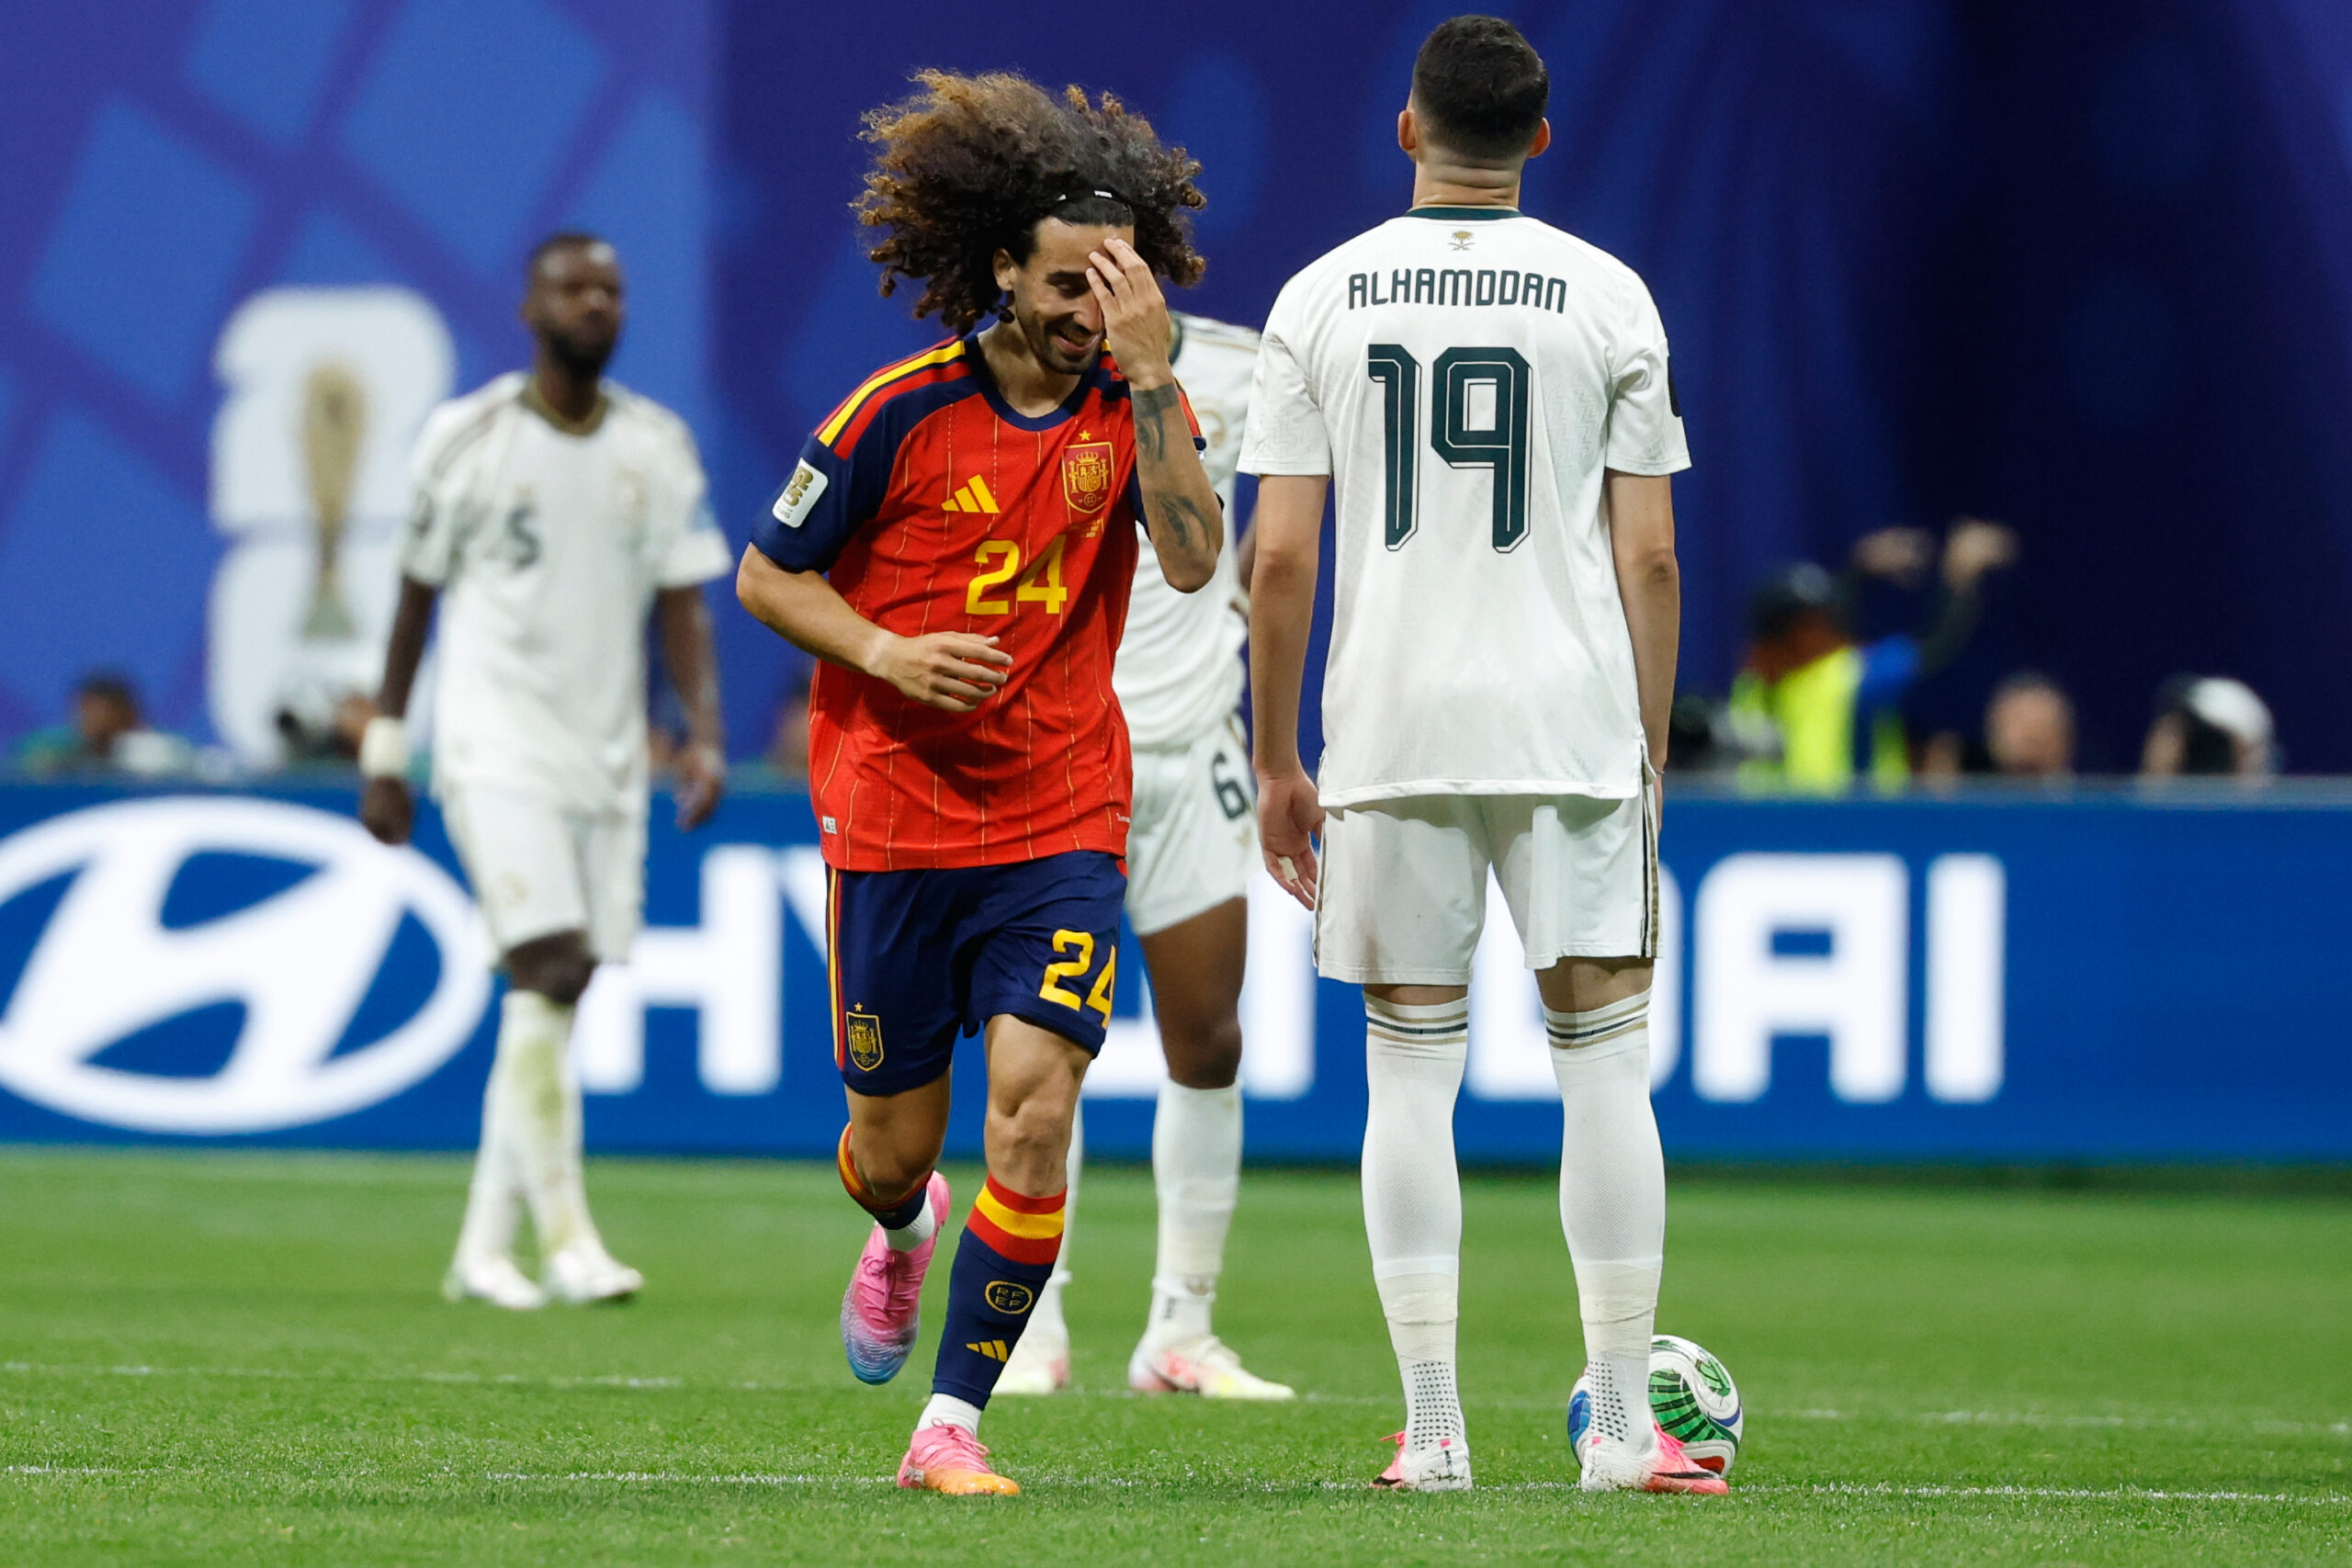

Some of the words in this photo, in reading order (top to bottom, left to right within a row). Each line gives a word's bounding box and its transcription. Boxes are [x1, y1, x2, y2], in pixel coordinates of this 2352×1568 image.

[1368, 344, 1533, 554] 19
[965, 535, 1068, 615] 24
[1212, 751, 1247, 819] 6
[1038, 929, 1117, 1029] 24
